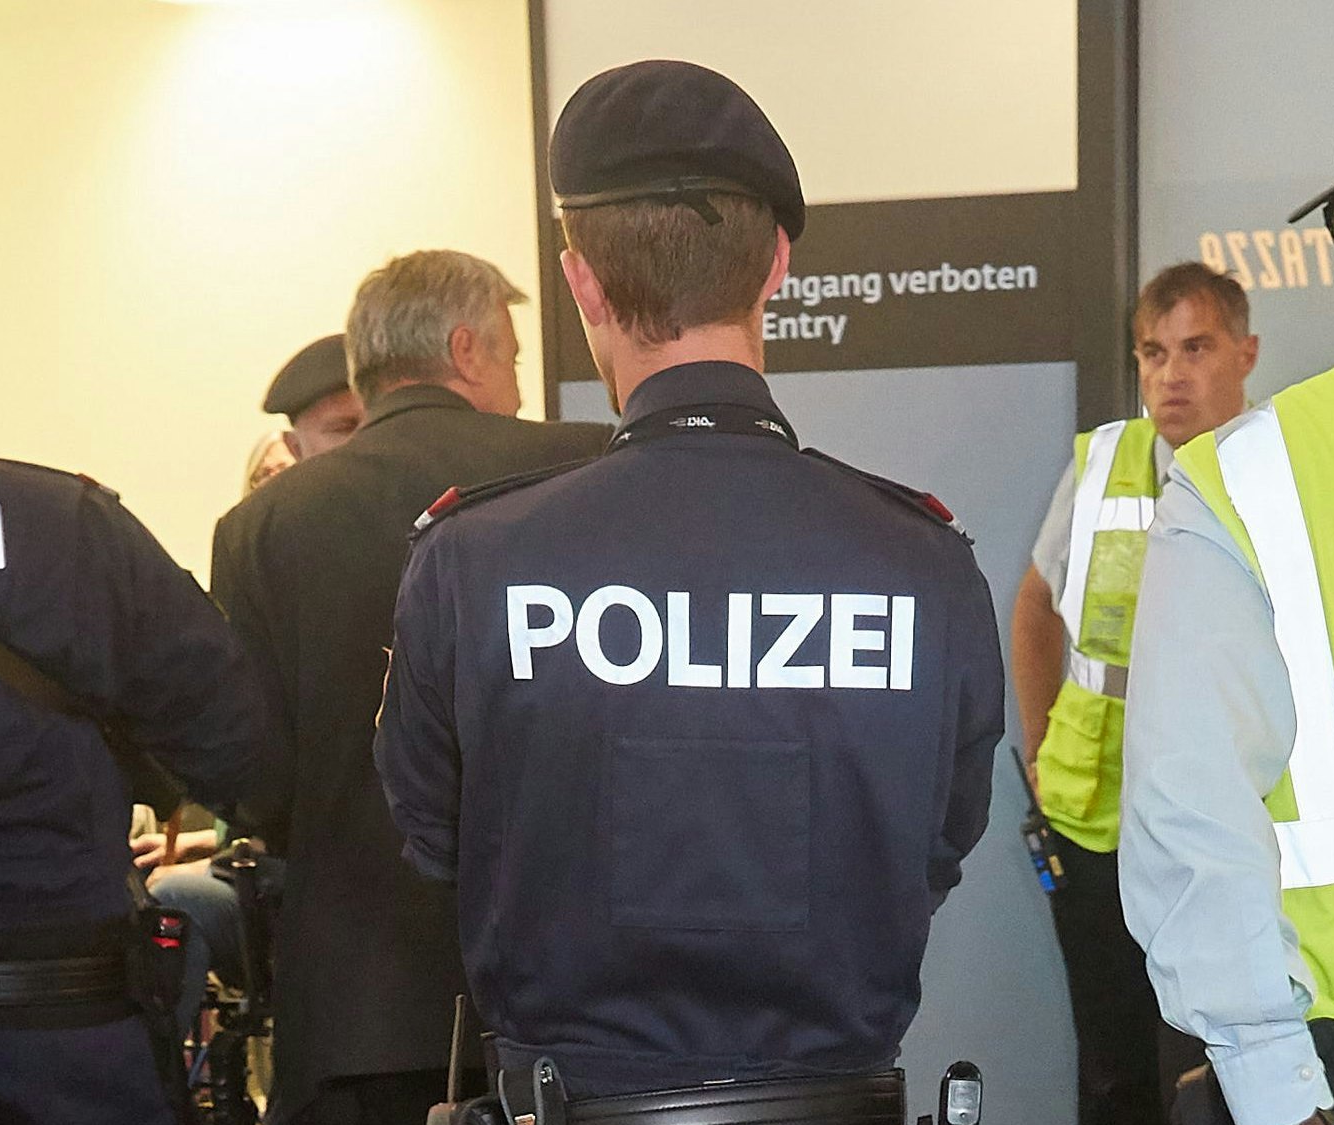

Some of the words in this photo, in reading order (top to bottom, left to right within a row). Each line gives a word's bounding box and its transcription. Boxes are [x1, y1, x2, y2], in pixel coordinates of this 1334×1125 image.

[771, 272, 882, 306] hgang
[888, 262, 1038, 294] verboten
[762, 312, 847, 345] Entry
[506, 584, 916, 691] POLIZEI
